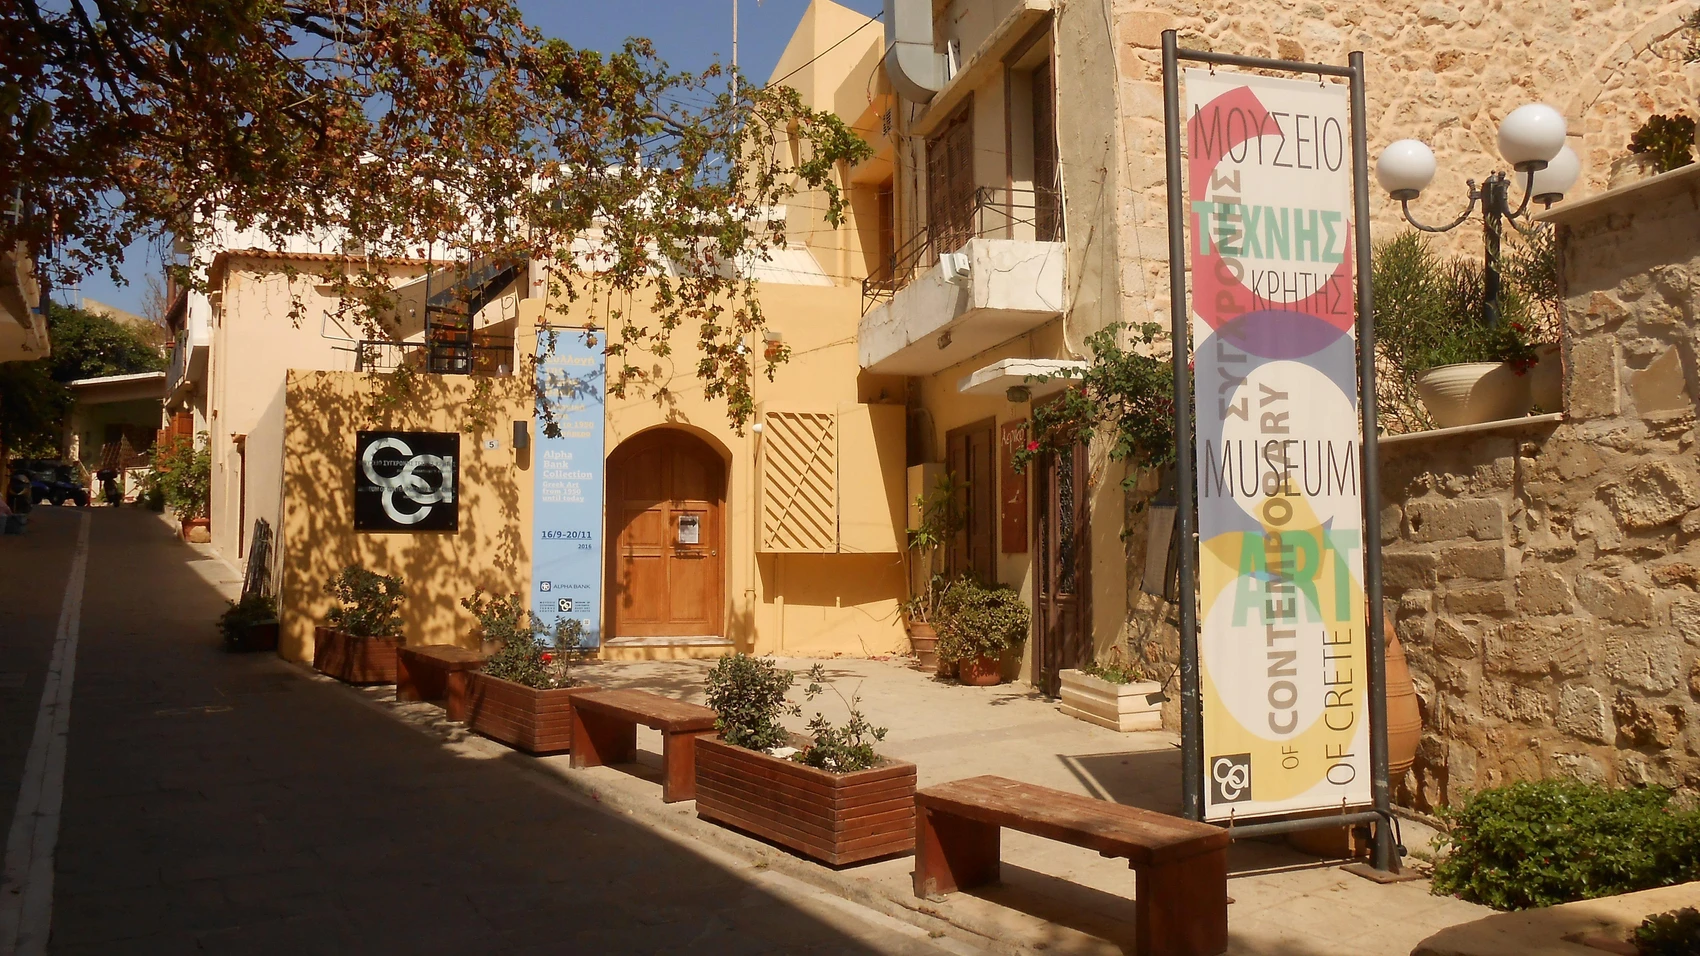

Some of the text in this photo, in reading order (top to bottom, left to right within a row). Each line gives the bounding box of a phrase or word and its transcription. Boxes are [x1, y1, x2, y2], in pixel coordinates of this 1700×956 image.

[1194, 103, 1344, 172] ΜΟΥΣΕΙΟ
[1191, 201, 1344, 264] ΤΕΧΝΗΣ
[1251, 269, 1347, 315] ΚΡΗΤΗΣ
[489, 440, 495, 449] 5
[543, 450, 573, 460] Alpha
[543, 460, 569, 469] Bank
[543, 470, 593, 479] Collection
[1204, 439, 1356, 498] MUSEUM
[563, 495, 584, 503] today
[541, 530, 593, 539] 16/9-20/11
[1230, 528, 1360, 628] ART
[1258, 382, 1300, 770] OF CONTEMPORARY
[1321, 628, 1357, 786] OF CRETE
